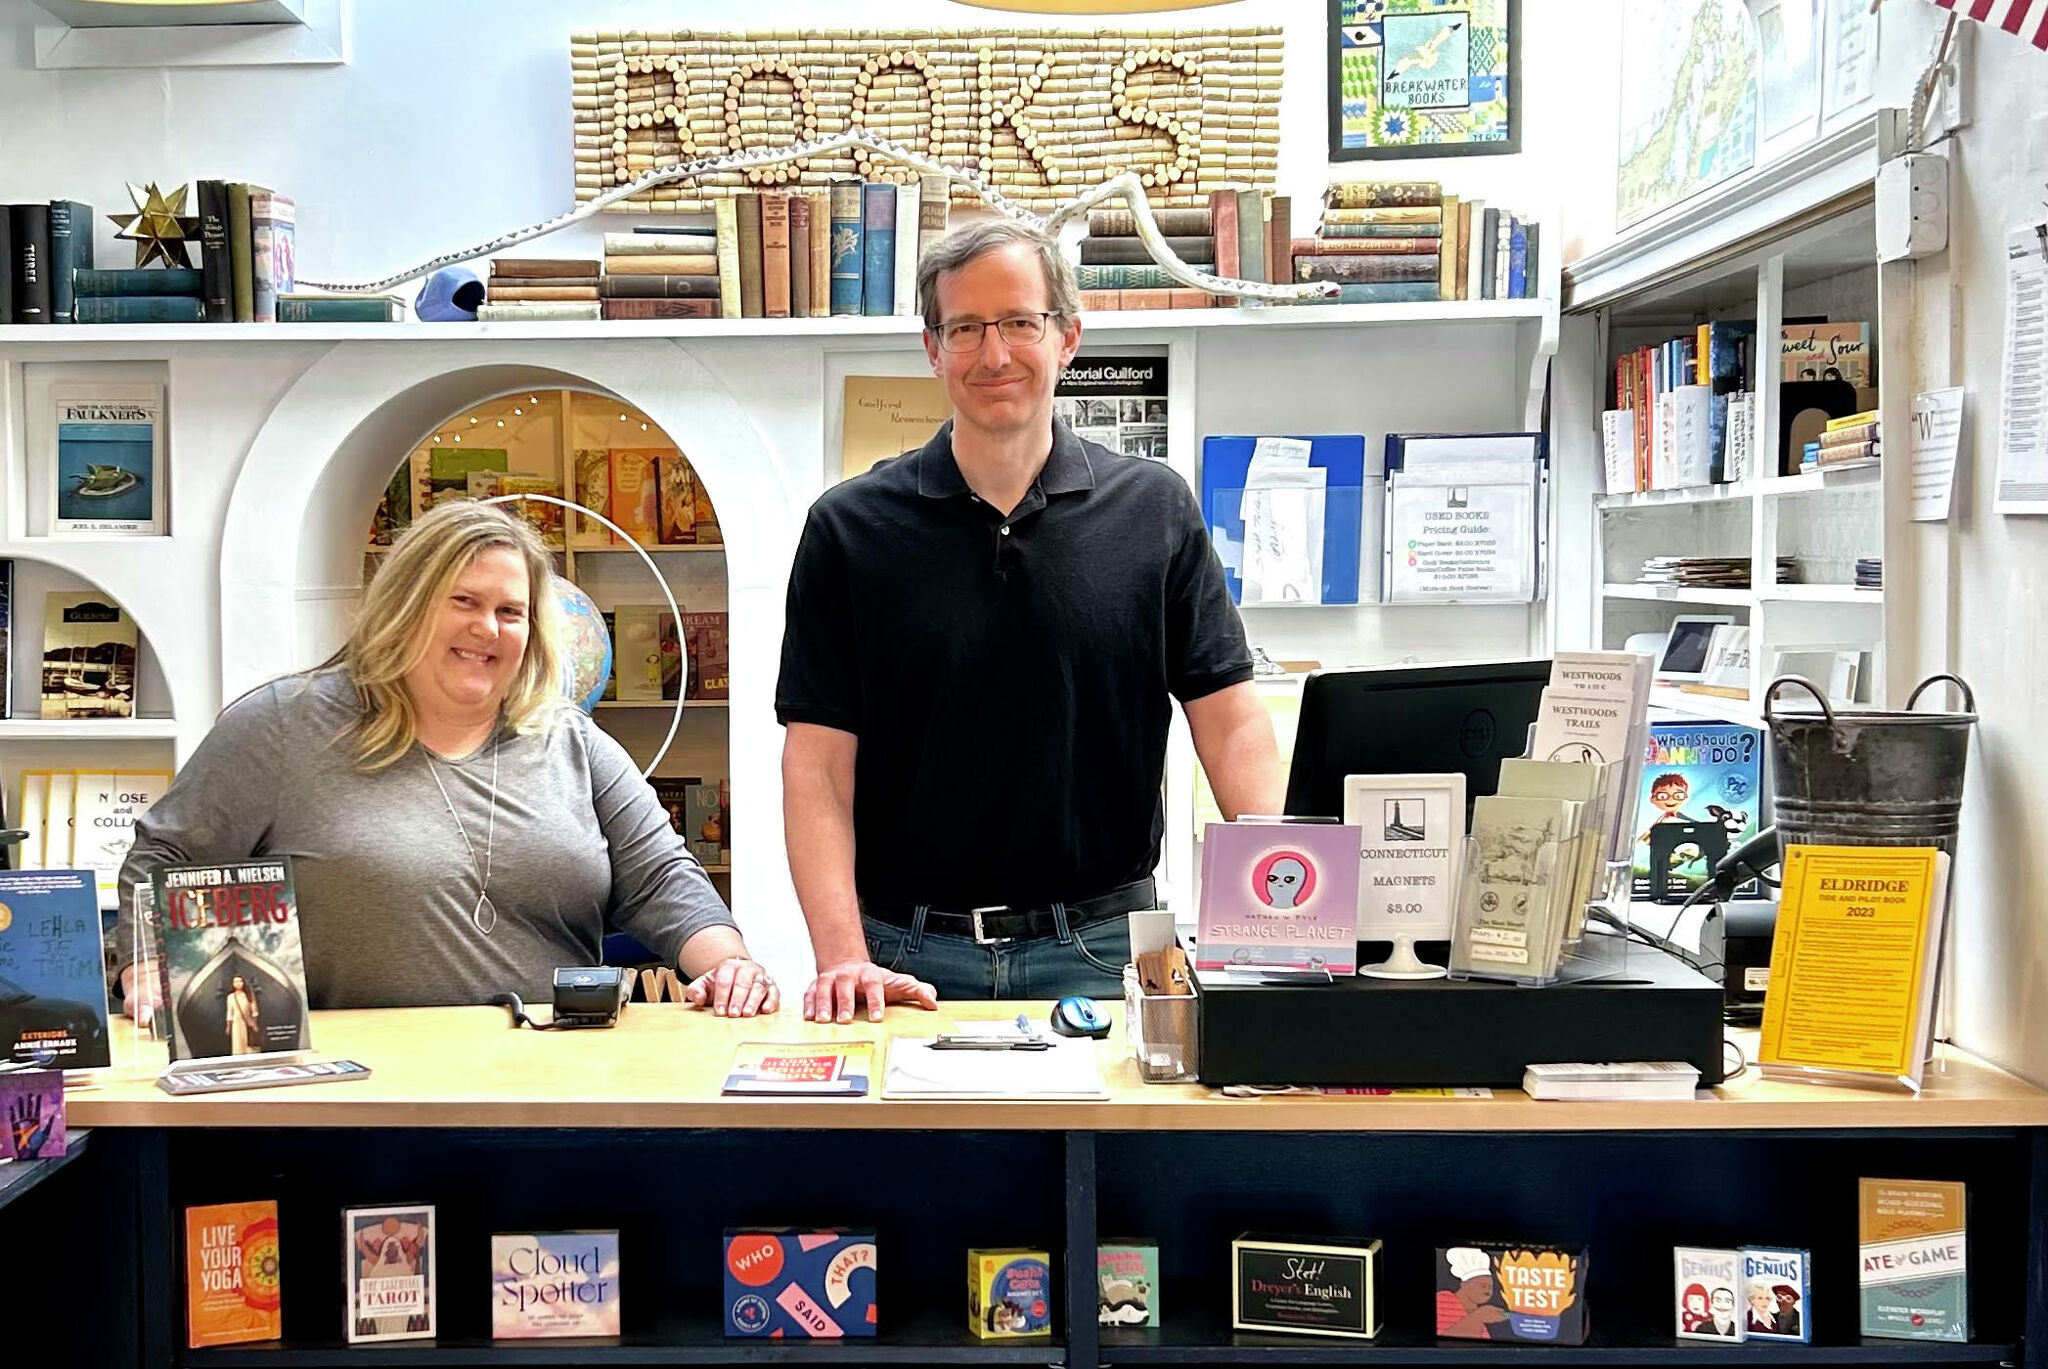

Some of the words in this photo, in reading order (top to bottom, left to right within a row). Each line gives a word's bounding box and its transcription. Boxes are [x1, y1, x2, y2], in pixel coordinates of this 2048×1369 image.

[1385, 78, 1466, 94] BREAKWATER
[1408, 92, 1445, 105] BOOKS
[613, 47, 1197, 187] BOOKS
[23, 243, 37, 284] THREE
[1782, 328, 1816, 353] weet
[1826, 333, 1864, 365] Sour
[1060, 367, 1102, 380] ictorial
[1103, 366, 1154, 380] Guilford
[1424, 511, 1453, 521] USED
[1455, 511, 1490, 521] BOOKS
[1423, 526, 1458, 535] Pricing
[1562, 671, 1622, 681] WESTWOODS
[1552, 706, 1618, 718] WESTWOODS
[1565, 718, 1600, 729] TRAILS
[1658, 734, 1689, 746] What
[1695, 732, 1738, 746] Should
[113, 806, 133, 815] and
[1360, 848, 1449, 859] CONNECTICUT
[165, 869, 222, 888] JENNIFER
[223, 872, 236, 884] A.
[237, 866, 285, 883] NIELSEN
[1373, 876, 1436, 887] MAGNETS
[1820, 878, 1909, 893] ELDRIDGE
[168, 884, 288, 930] ICEBERG
[1386, 903, 1422, 914] $5.00
[1884, 896, 1906, 904] BOOK
[1846, 907, 1875, 917] 2023
[1211, 924, 1278, 938] STRANGE
[1285, 924, 1352, 940] PLANET
[202, 1225, 236, 1248] LIVE
[201, 1246, 242, 1270] YOUR
[509, 1247, 600, 1276] Cloud
[735, 1244, 774, 1271] WHO
[831, 1249, 869, 1286] THAT?
[1863, 1255, 1894, 1272] ATE
[1908, 1245, 1960, 1265] GAME
[1281, 1257, 1325, 1280] Stet!
[1506, 1266, 1566, 1288] TASTE
[1681, 1257, 1733, 1282] GENIUS
[1745, 1256, 1798, 1281] GENIUS
[201, 1270, 243, 1292] YOGA
[1251, 1279, 1301, 1296] Dreyer's
[1304, 1283, 1352, 1300] English
[364, 1290, 419, 1305] TAROT
[502, 1277, 609, 1311] Spotter
[1512, 1289, 1561, 1309] TEST
[794, 1300, 826, 1333] SAID
